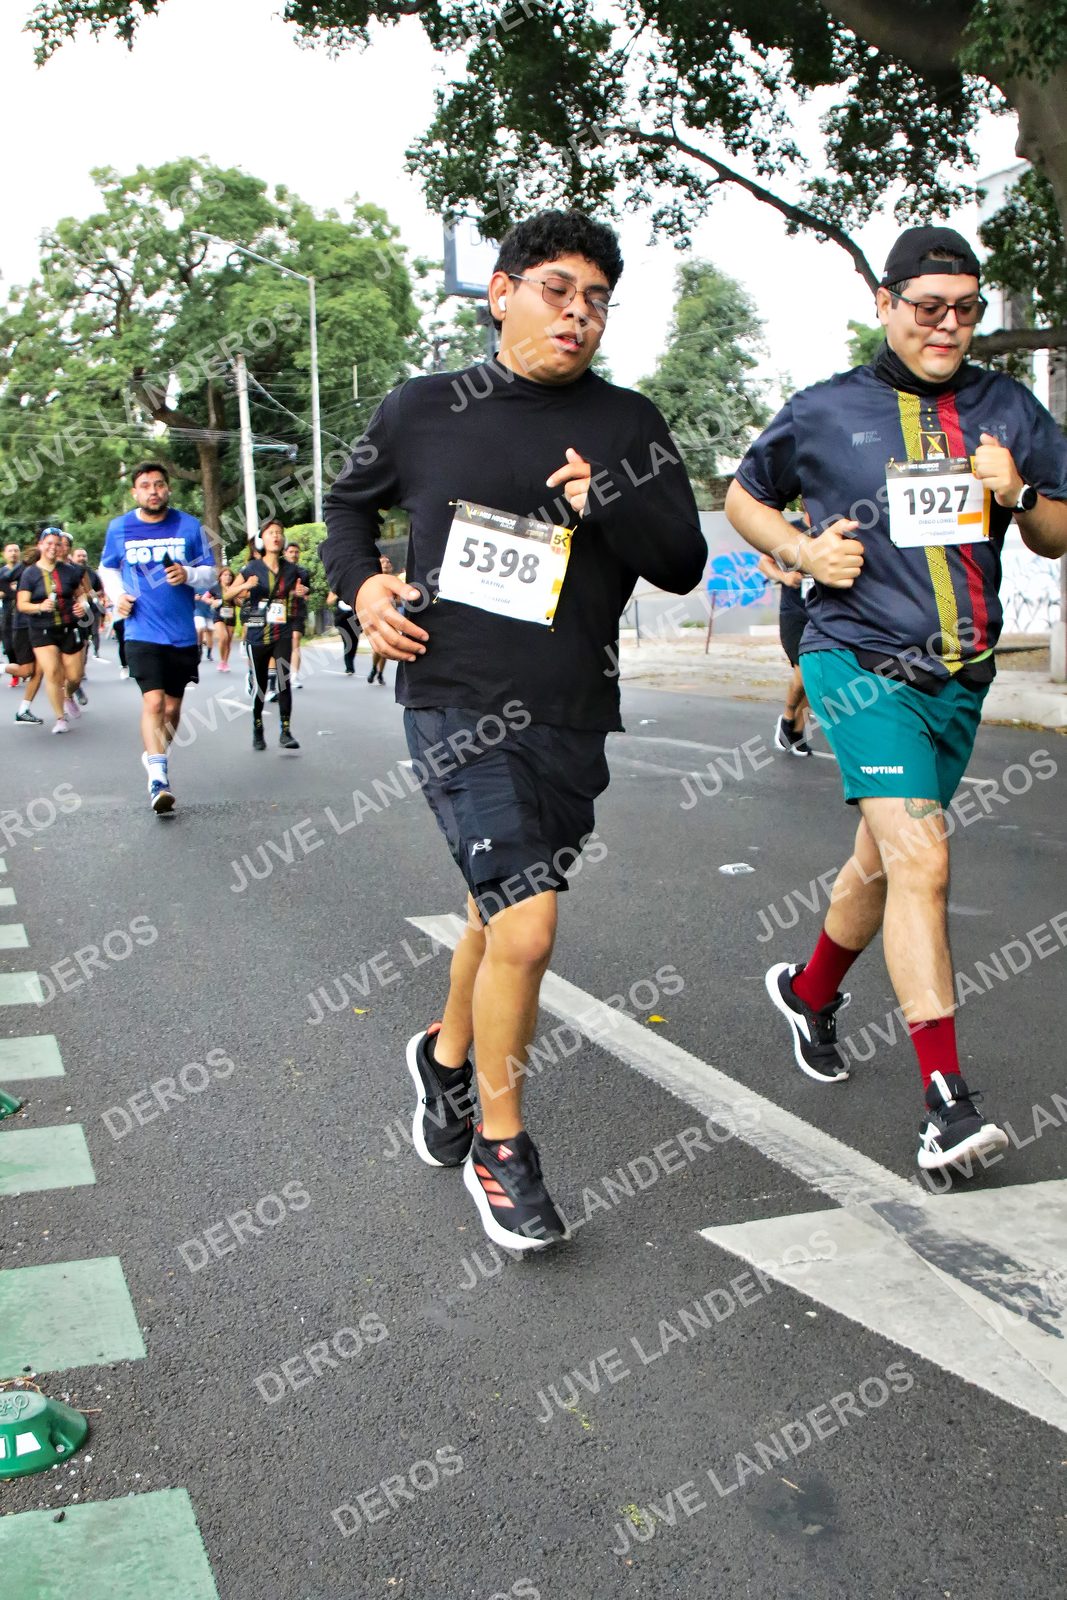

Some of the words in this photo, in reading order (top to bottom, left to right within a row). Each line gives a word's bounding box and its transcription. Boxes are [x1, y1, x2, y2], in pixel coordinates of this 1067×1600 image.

[903, 485, 970, 516] 1927
[459, 537, 540, 584] 5398
[860, 765, 904, 775] TOPTIME
